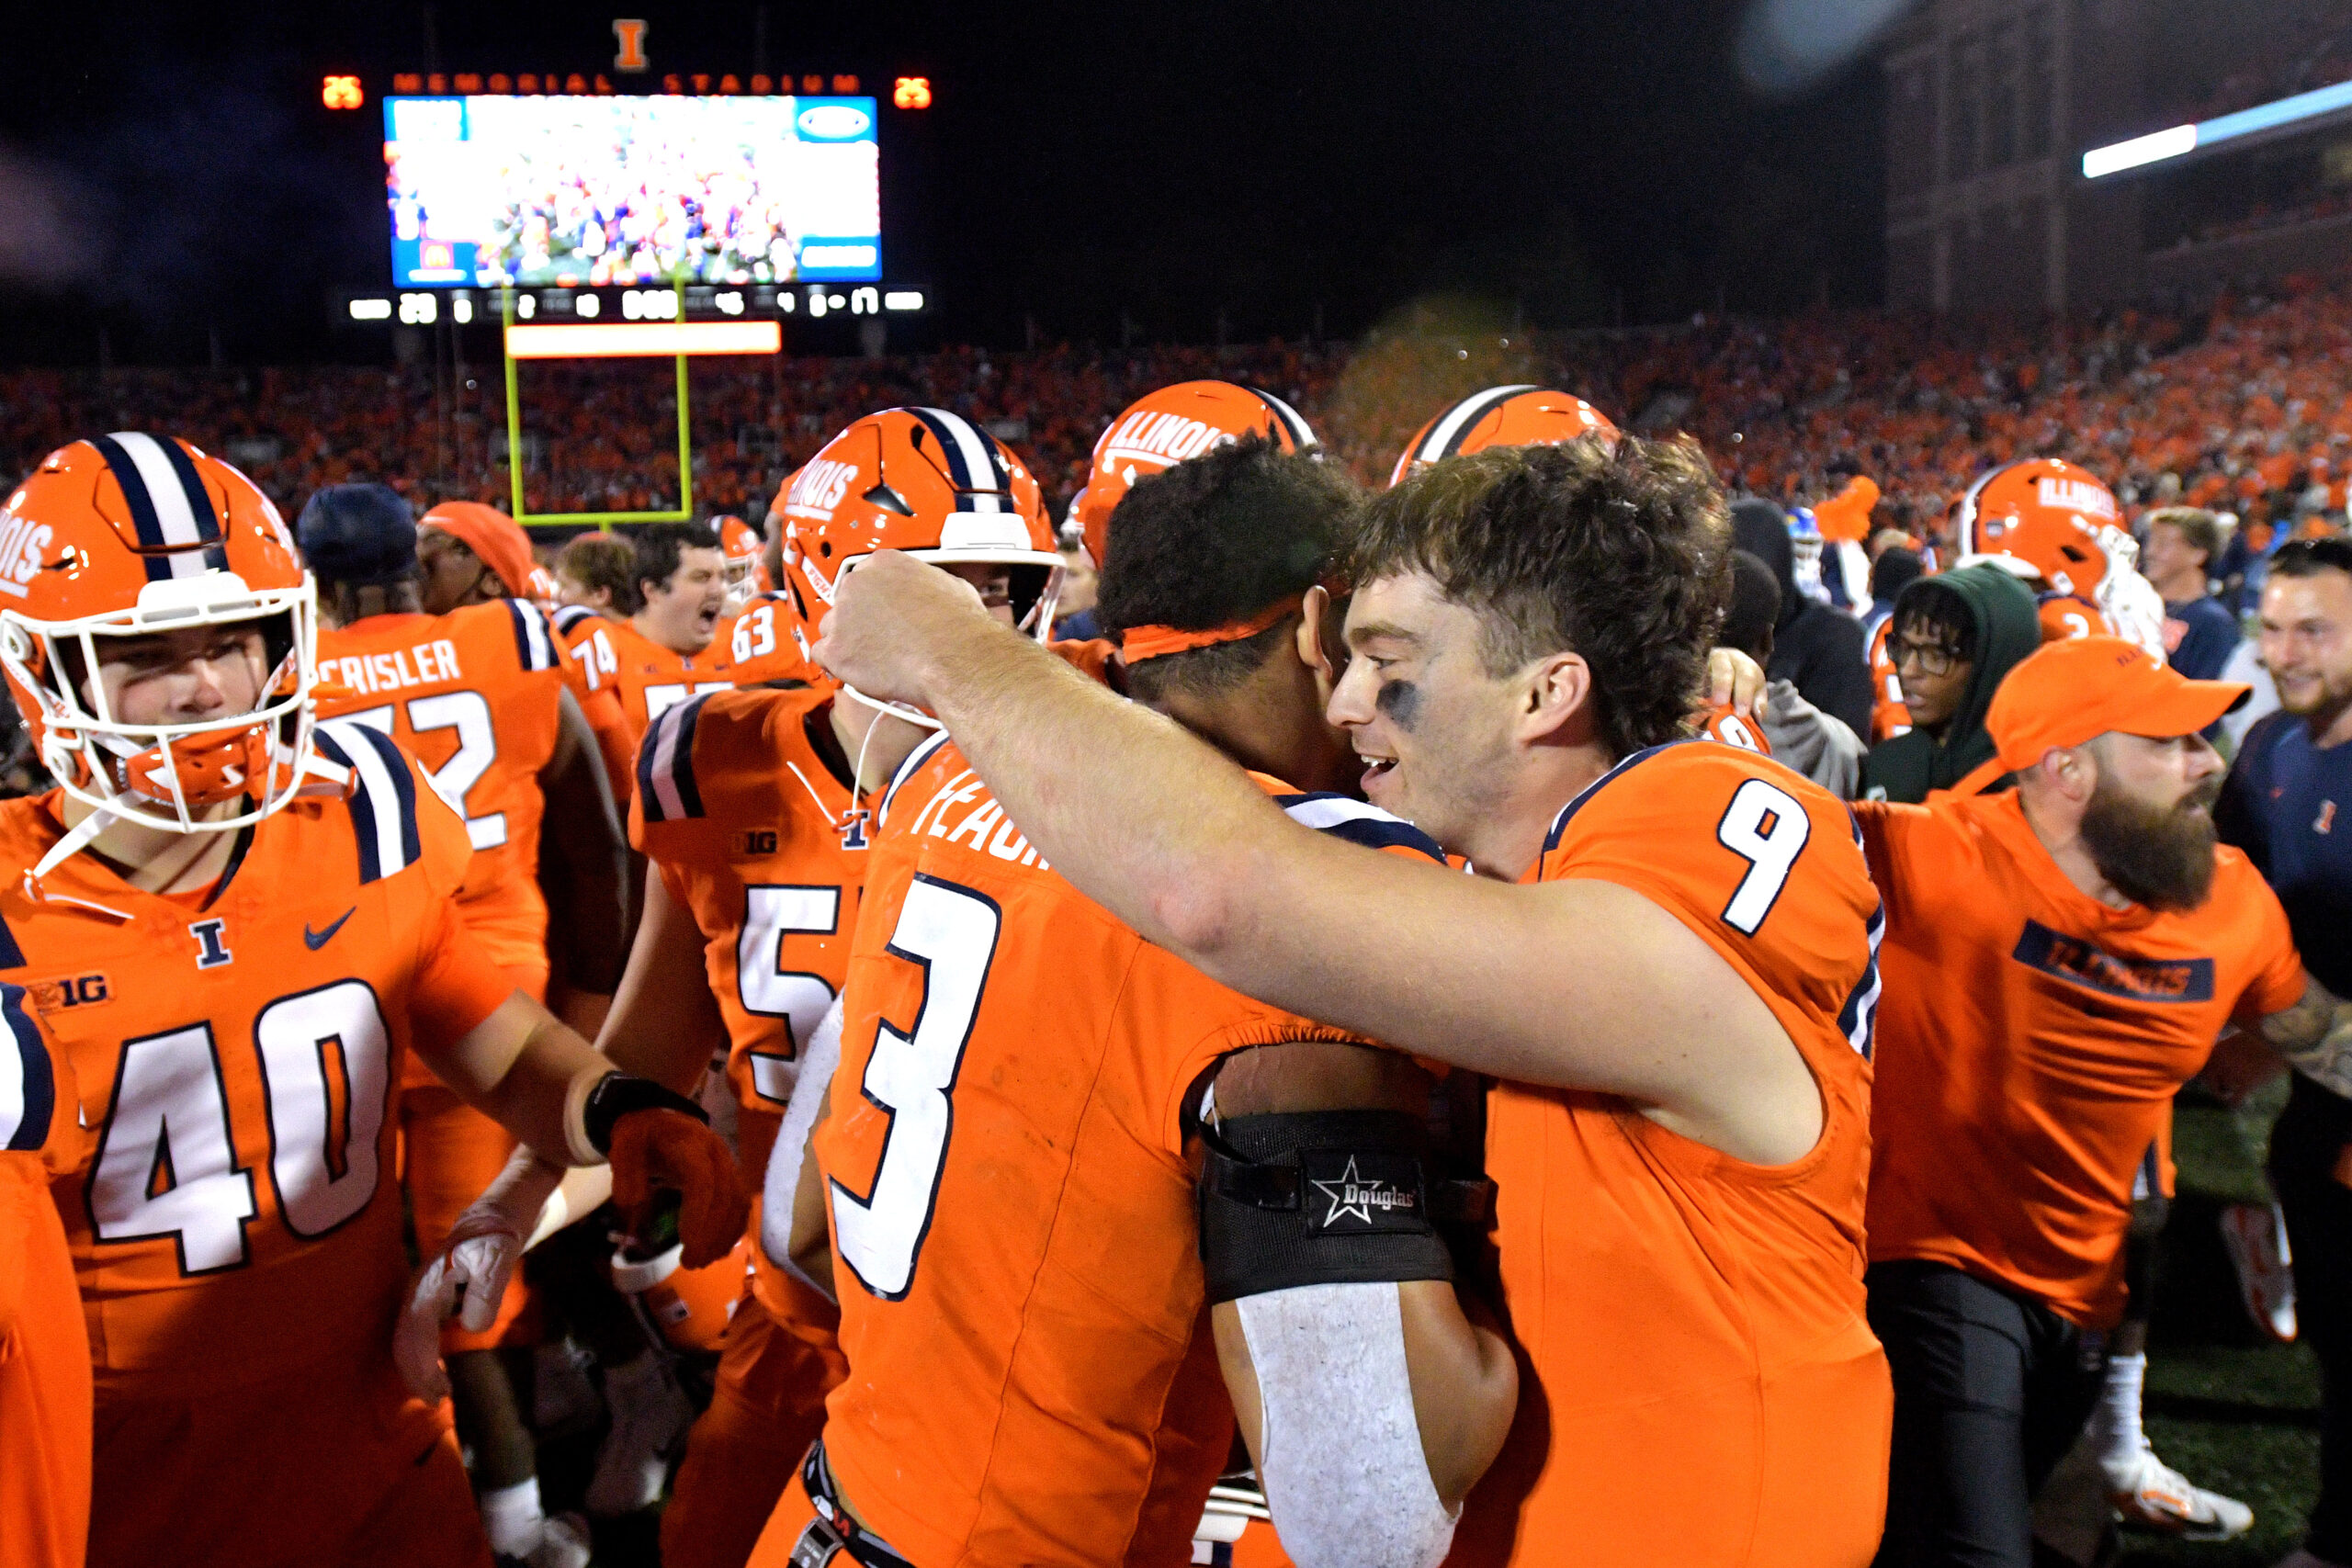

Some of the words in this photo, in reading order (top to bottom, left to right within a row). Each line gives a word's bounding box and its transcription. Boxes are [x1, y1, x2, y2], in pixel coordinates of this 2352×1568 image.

[393, 73, 613, 93] MEMORIAL
[662, 73, 860, 94] STADIUM
[318, 639, 461, 695] CRISLER
[570, 629, 616, 691] 74
[731, 605, 775, 664] 63
[315, 689, 508, 852] 2
[1716, 778, 1812, 939] 9
[736, 884, 853, 1106] 5
[89, 978, 390, 1279] 40
[827, 872, 1003, 1302] 3
[1342, 1183, 1415, 1211] Douglas
